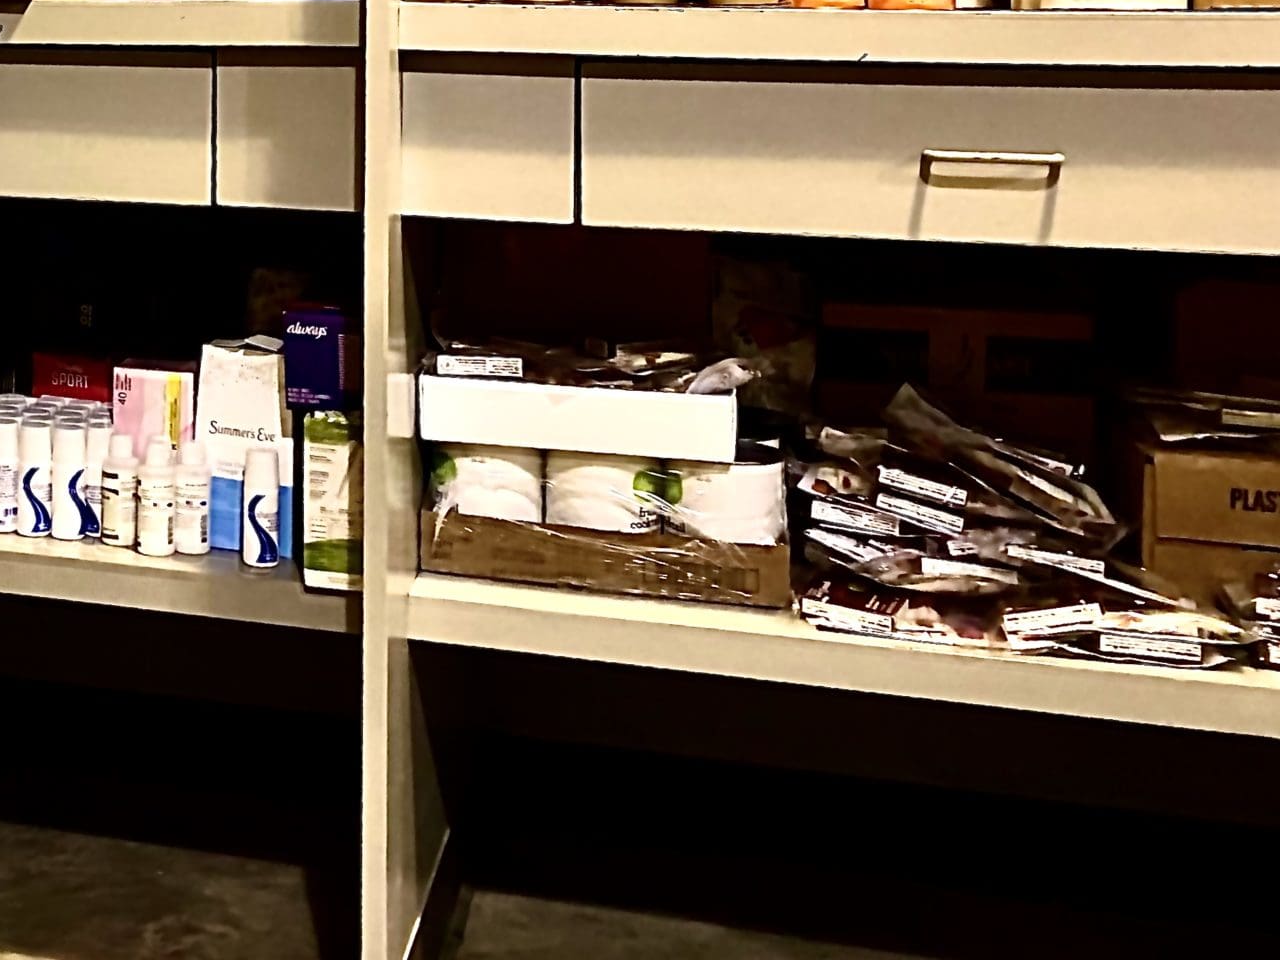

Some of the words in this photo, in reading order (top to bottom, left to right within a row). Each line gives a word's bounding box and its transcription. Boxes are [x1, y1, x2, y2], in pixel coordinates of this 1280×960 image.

[286, 321, 329, 340] always
[51, 371, 90, 389] SPORT
[208, 419, 257, 440] Summer's
[256, 427, 276, 443] Eve
